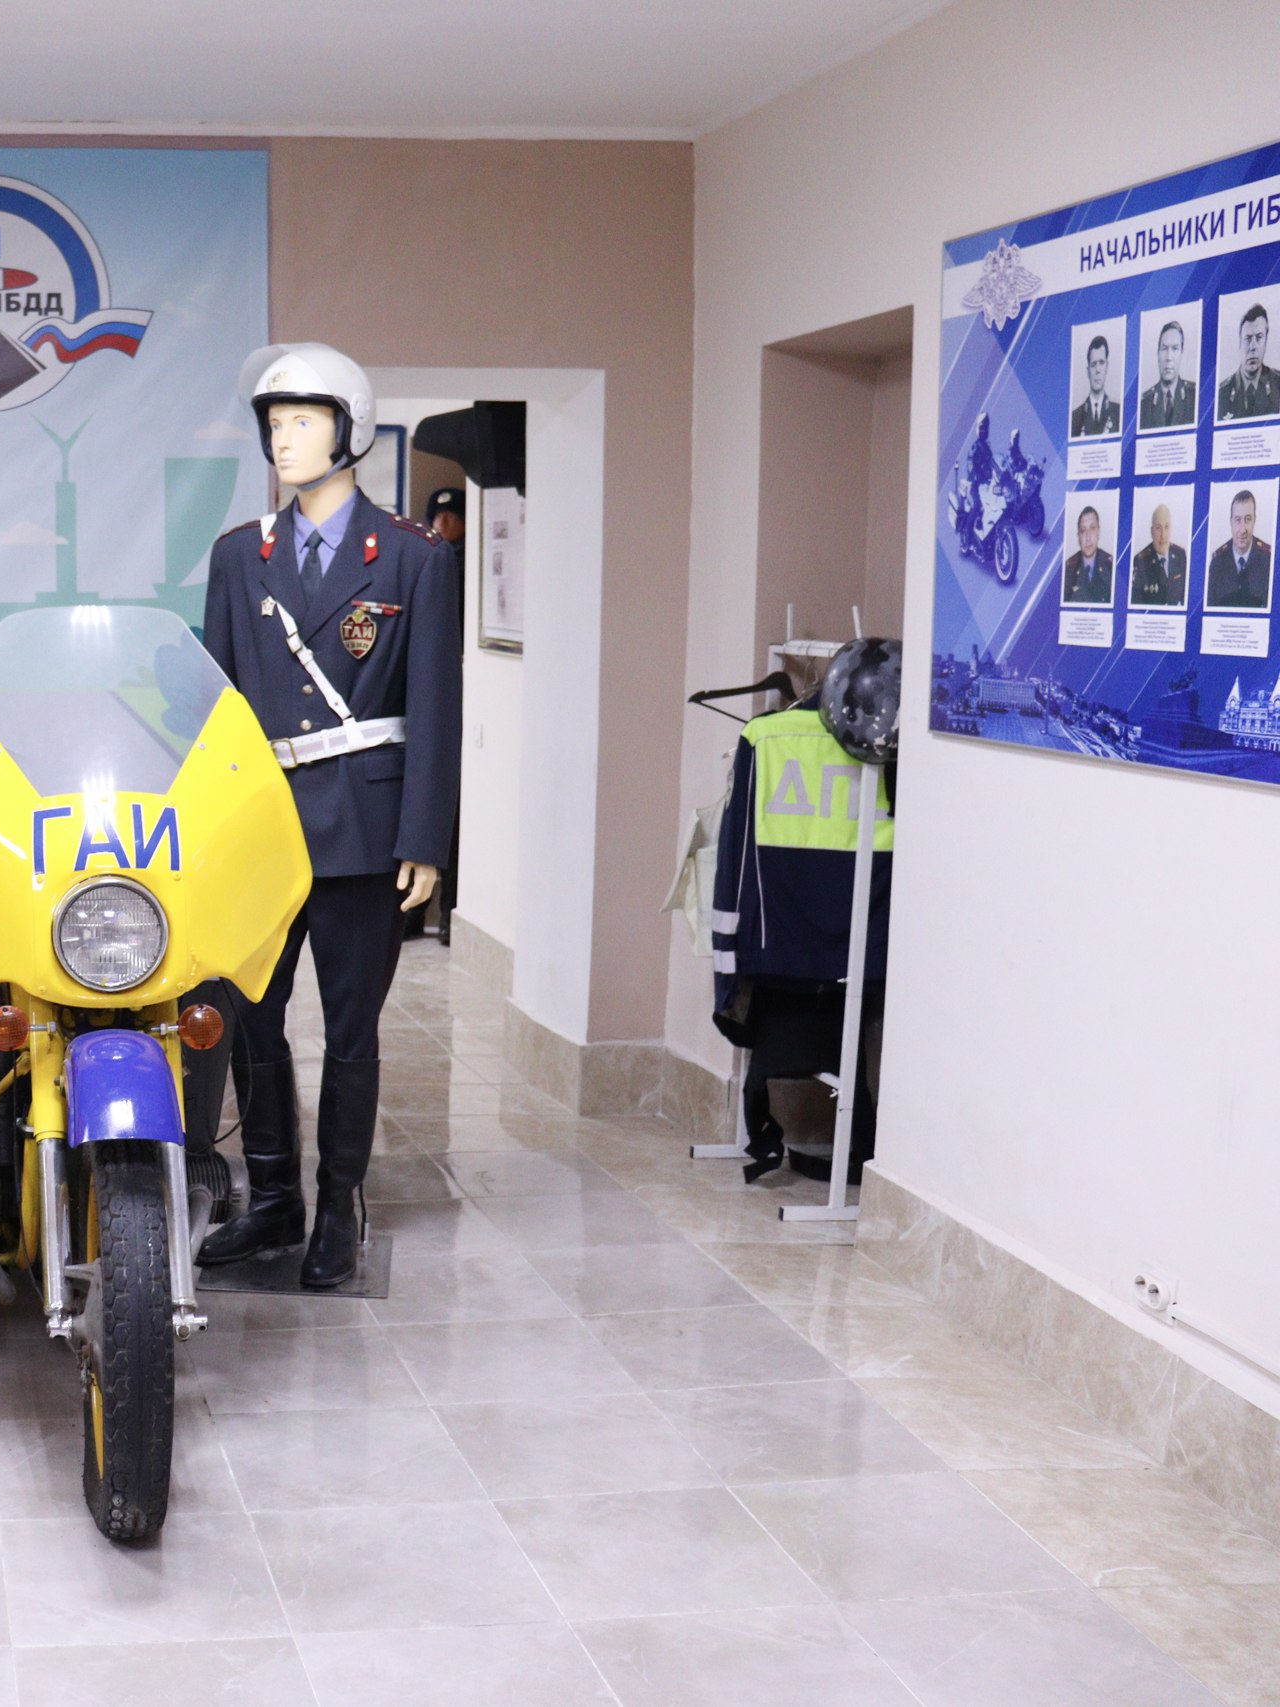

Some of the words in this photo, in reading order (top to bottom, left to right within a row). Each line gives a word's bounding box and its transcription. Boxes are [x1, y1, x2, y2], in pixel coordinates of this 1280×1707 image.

[1080, 208, 1225, 273] НАЧАЛЬНИКИ
[343, 625, 373, 638] ГАИ
[765, 759, 894, 820] ДП
[32, 803, 182, 875] ГАИ
